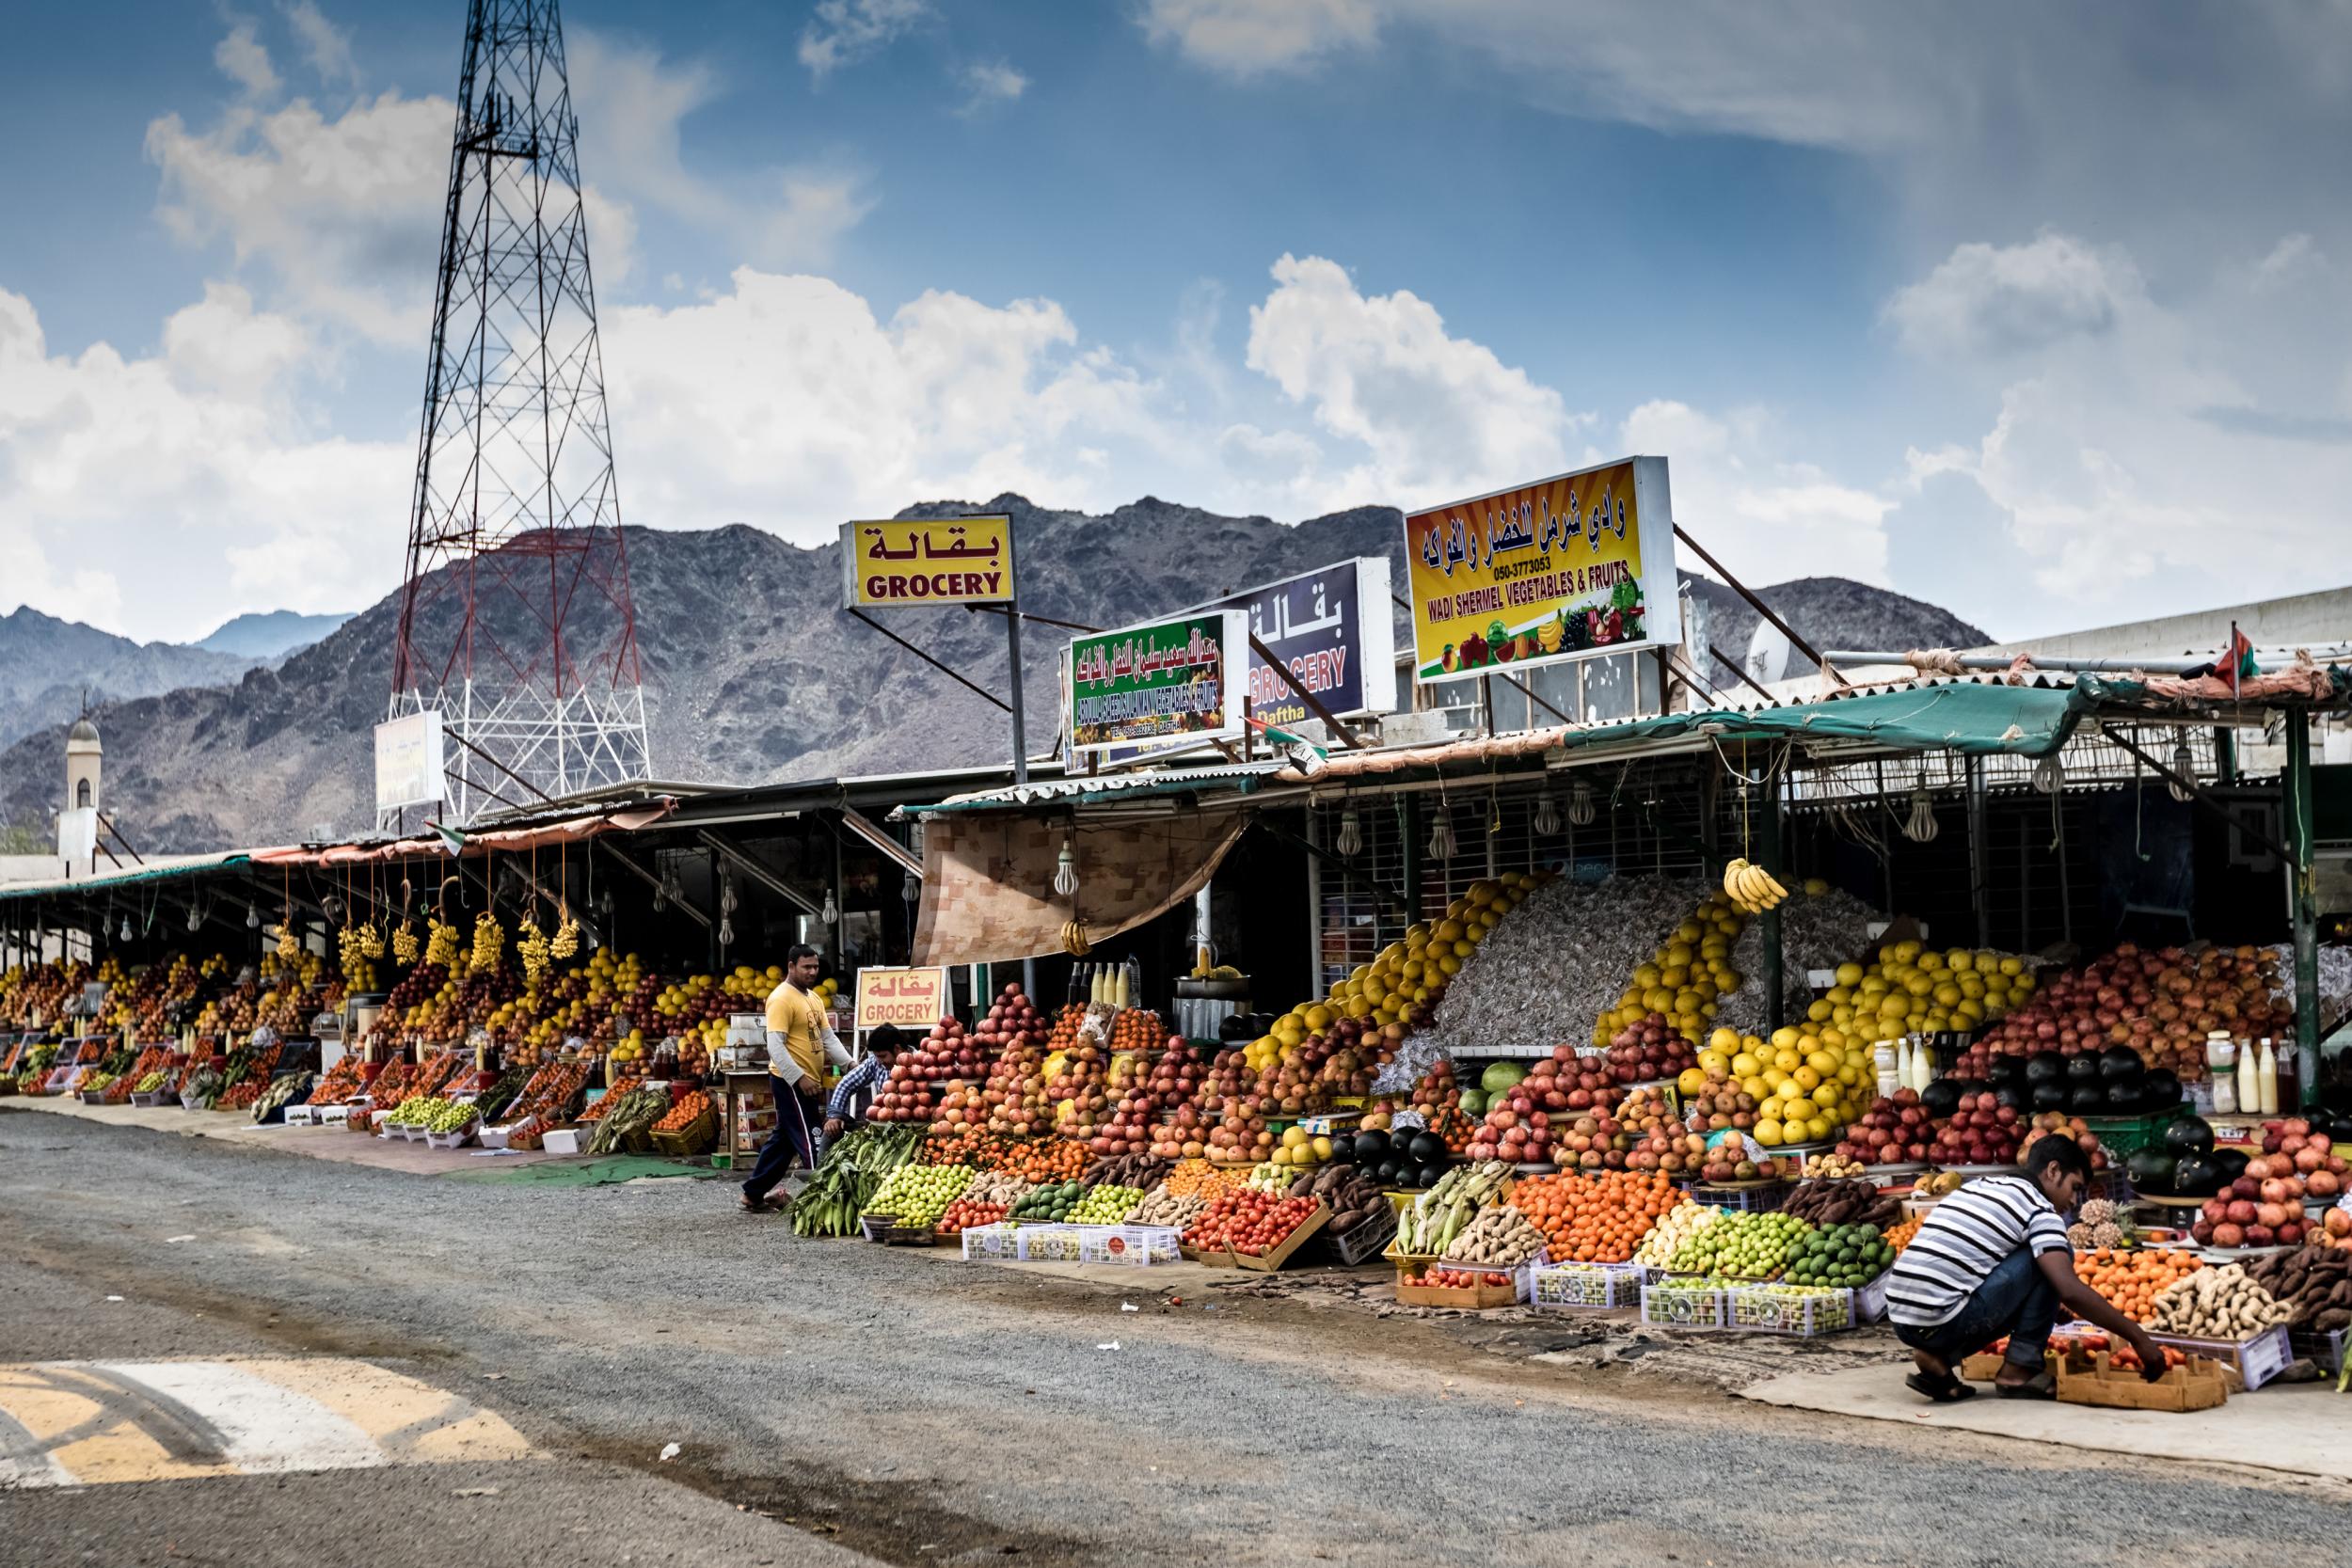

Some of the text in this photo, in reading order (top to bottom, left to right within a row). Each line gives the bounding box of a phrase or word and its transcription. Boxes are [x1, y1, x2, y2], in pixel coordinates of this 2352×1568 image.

[1538, 489, 1582, 555] شرمل
[1587, 483, 1627, 553] وادي
[864, 526, 1000, 567] بقالة
[866, 571, 1002, 599] GROCERY
[1494, 555, 1552, 581] 050-3773053
[1428, 560, 1630, 623] WADI SHERMEL VEGETABLES & FRUITS
[1249, 645, 1346, 706] GROCERY
[1121, 688, 1152, 721] SULAIMAN
[1152, 683, 1190, 718] VEGETABLES
[1197, 679, 1218, 712] FRUITS
[1257, 705, 1306, 724] Daftha
[868, 975, 934, 1002] بقالة
[866, 1003, 932, 1021] GROCERY
